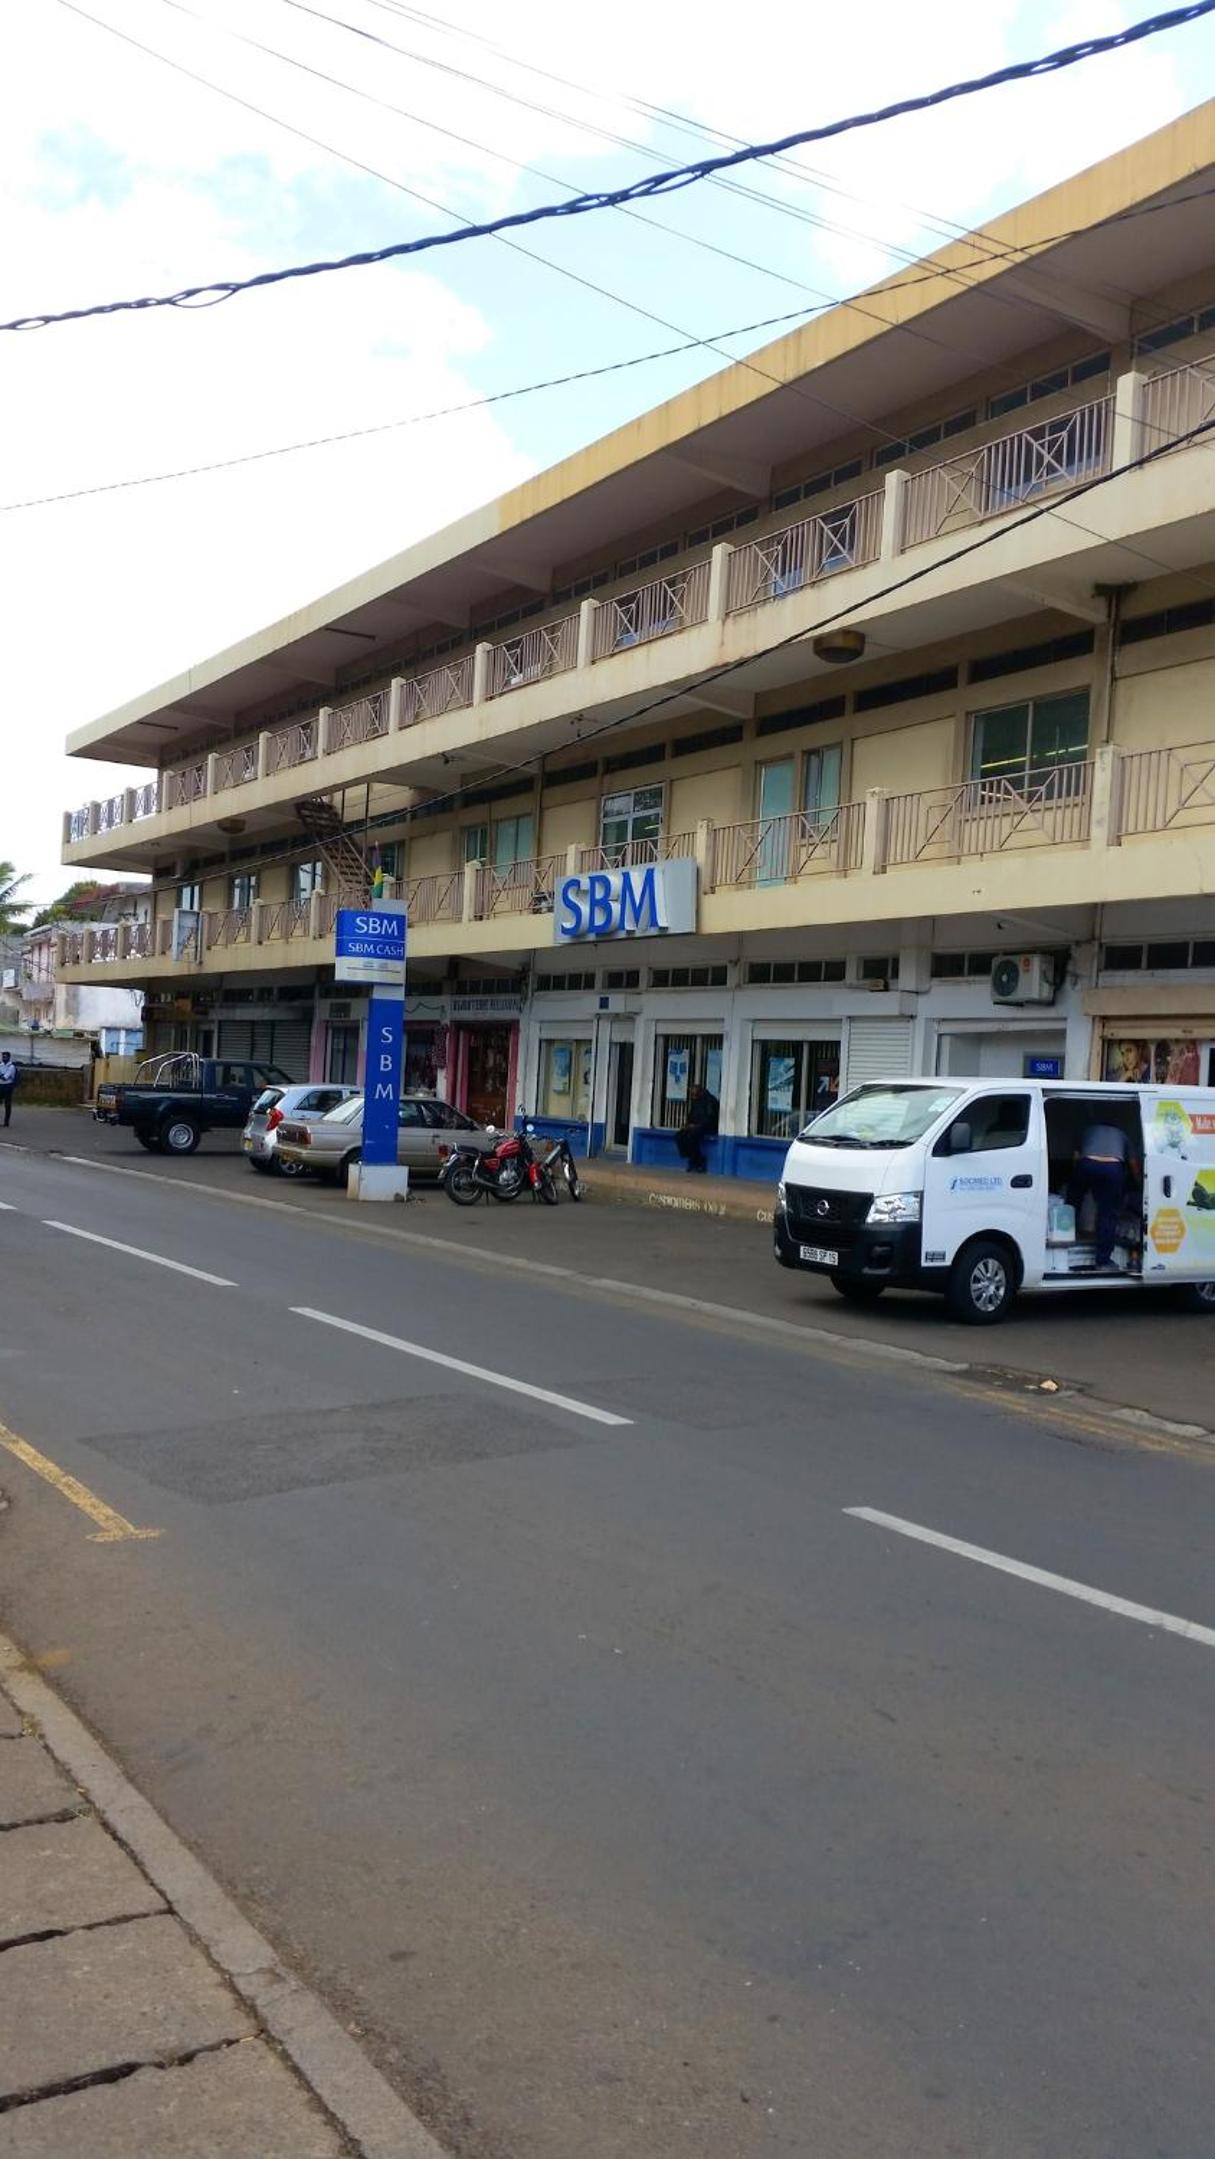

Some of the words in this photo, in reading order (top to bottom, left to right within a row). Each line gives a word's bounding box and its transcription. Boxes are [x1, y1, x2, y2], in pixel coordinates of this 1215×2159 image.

[561, 867, 661, 936] SBM
[355, 916, 398, 937] SBM
[348, 942, 375, 954] SBM
[376, 945, 404, 957] CASH
[375, 1026, 394, 1100] SBM
